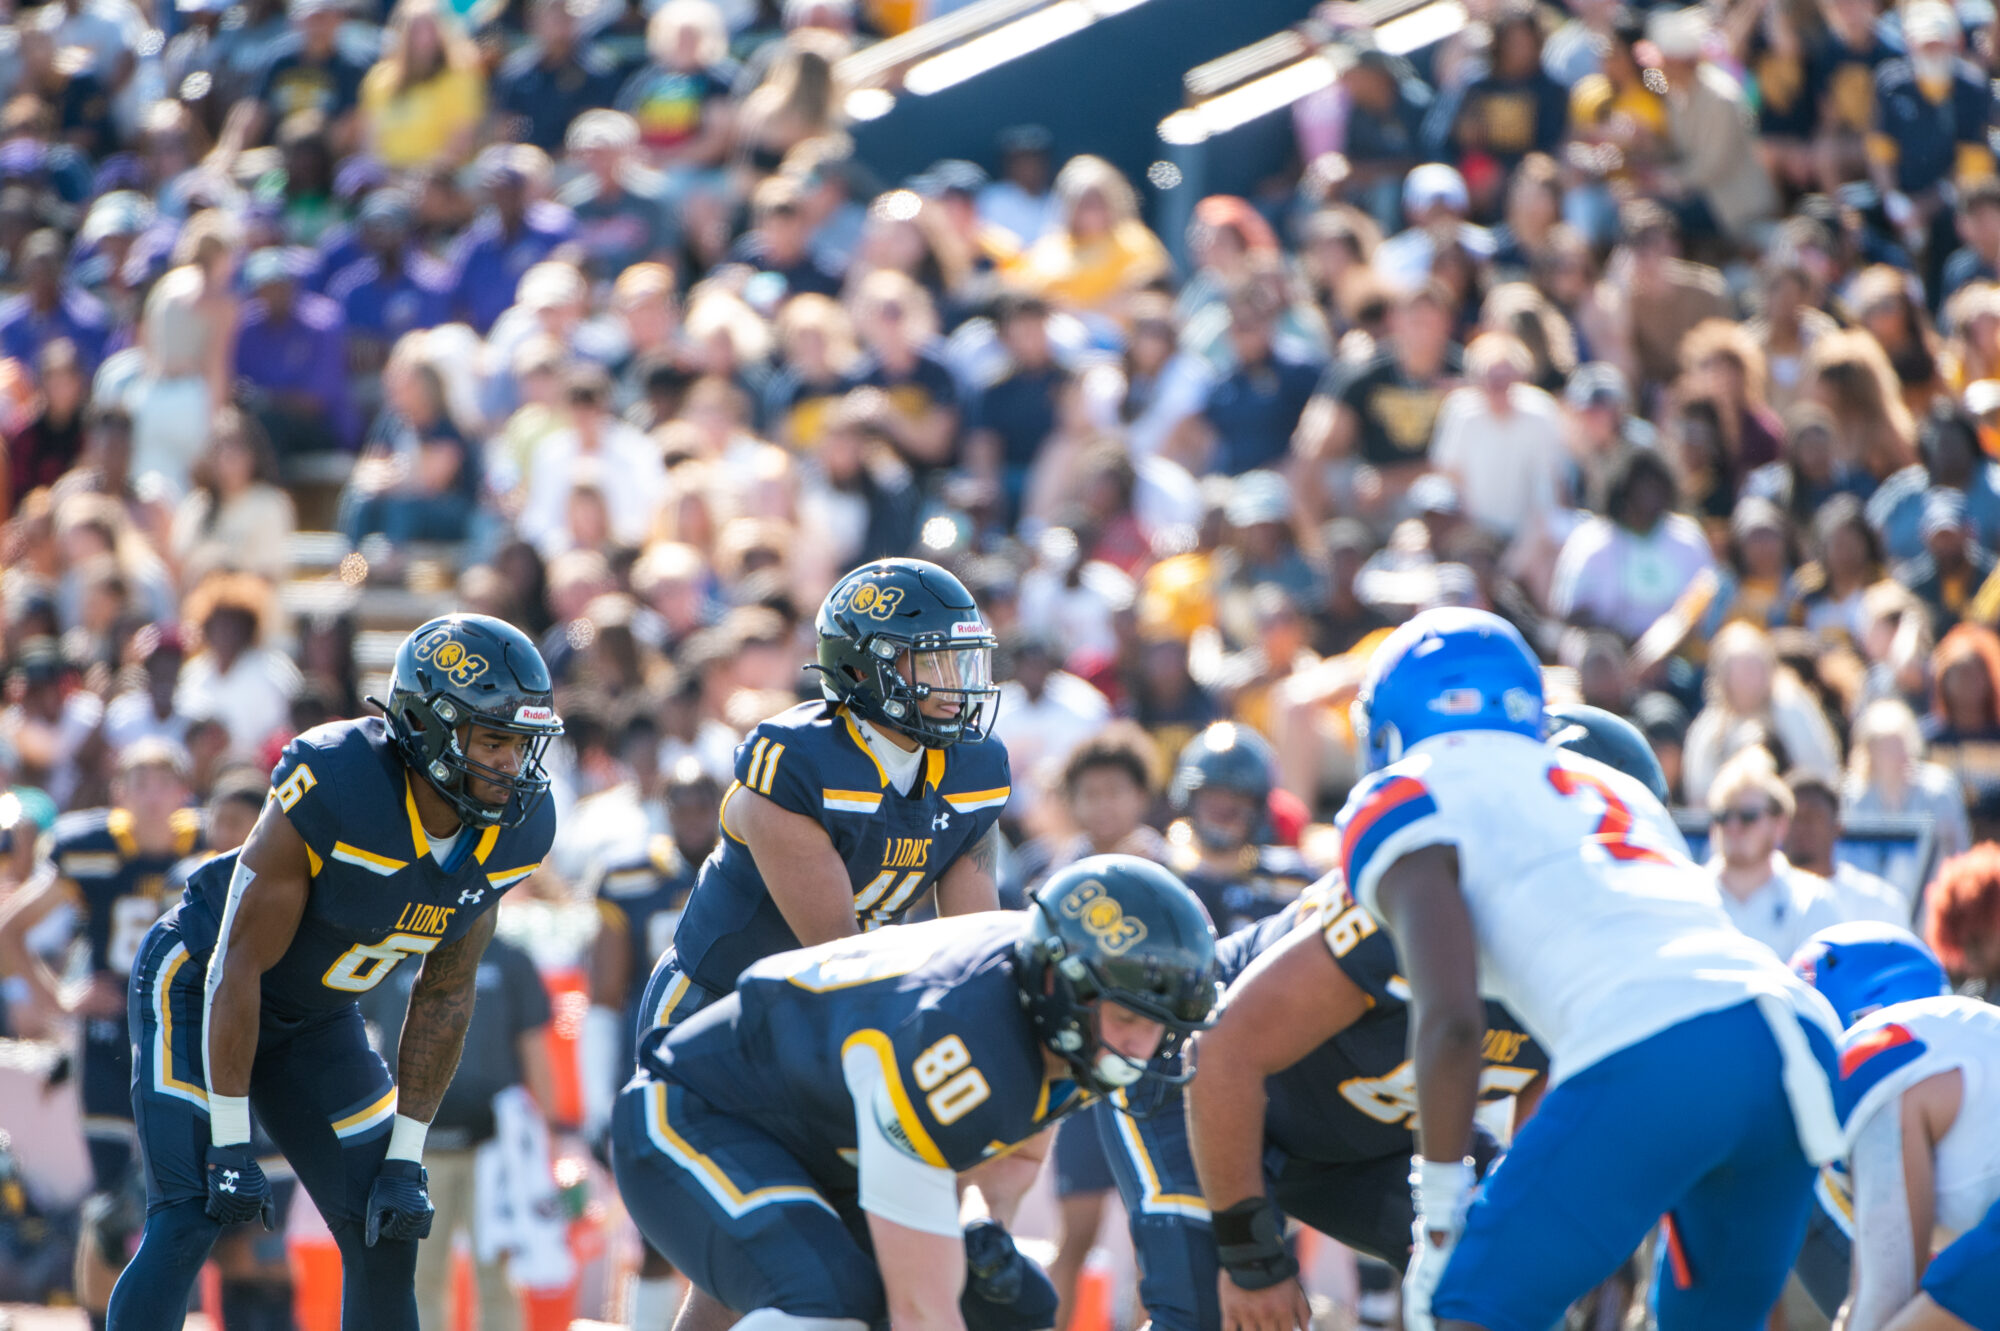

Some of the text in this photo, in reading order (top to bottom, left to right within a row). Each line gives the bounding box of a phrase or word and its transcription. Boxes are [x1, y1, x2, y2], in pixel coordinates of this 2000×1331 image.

[274, 763, 318, 814] 6
[746, 737, 785, 795] 11
[1546, 766, 1678, 867] 2
[881, 838, 932, 867] LIONS
[394, 902, 456, 935] LIONS
[322, 932, 443, 993] 6
[1481, 1029, 1531, 1063] IONS
[912, 1034, 992, 1126] 80
